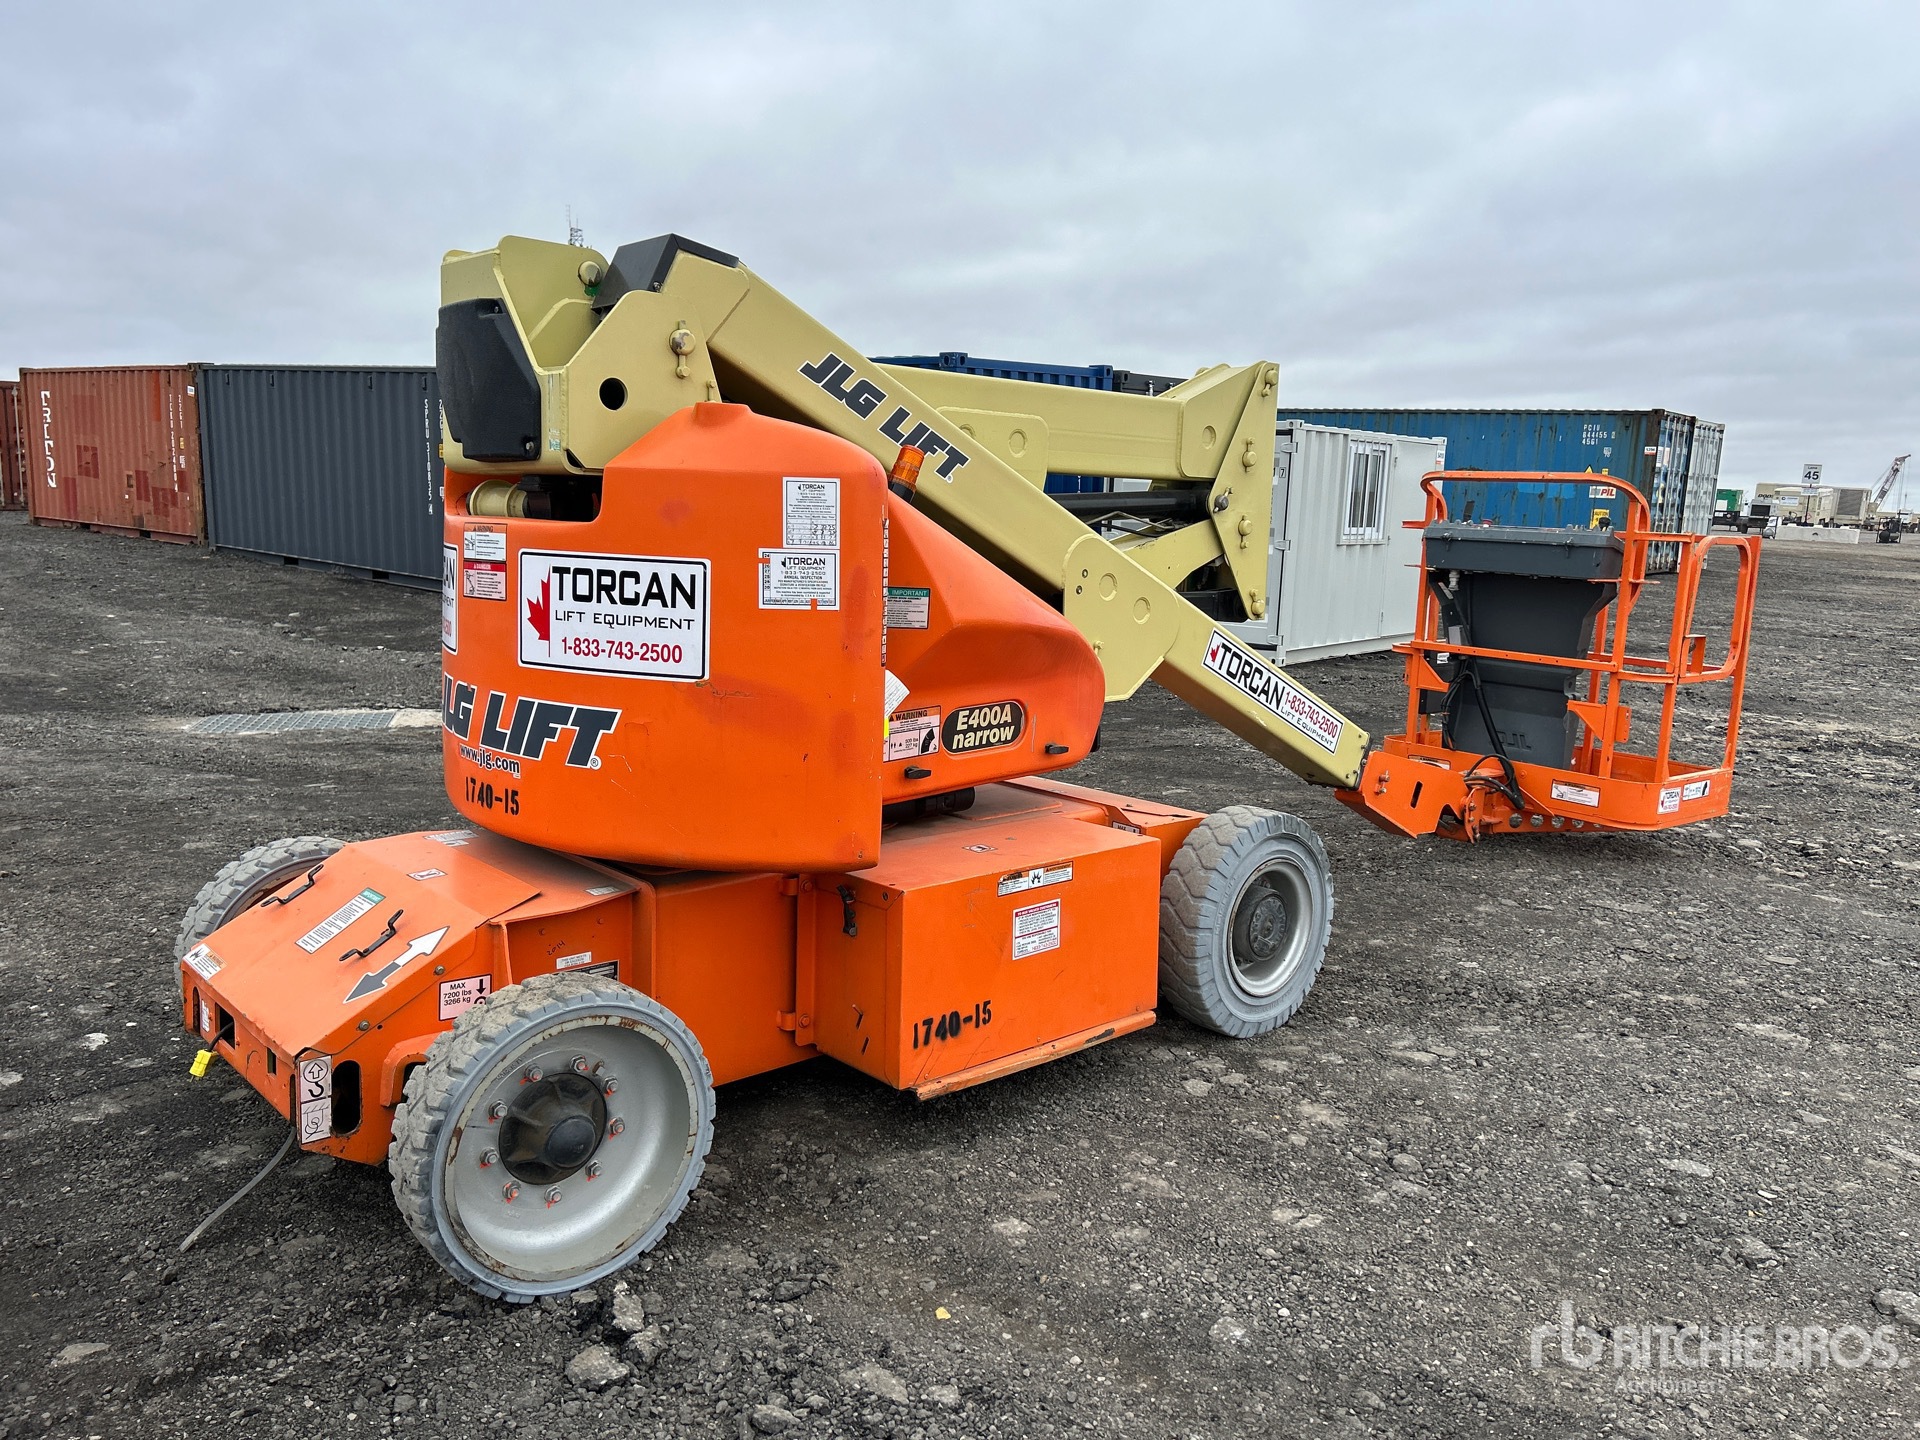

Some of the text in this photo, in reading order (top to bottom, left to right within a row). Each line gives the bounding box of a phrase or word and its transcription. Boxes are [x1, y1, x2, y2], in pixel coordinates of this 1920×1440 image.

[797, 351, 971, 479] JLG LIFT
[1611, 431, 1616, 439] 2
[1804, 471, 1819, 480] 45
[1600, 488, 1615, 497] PIL
[786, 557, 826, 566] TORCAN
[552, 565, 697, 610] TORCAN
[555, 609, 695, 630] LIFT EQUIPMENT
[561, 636, 683, 664] 1-833-743-2500
[1217, 642, 1286, 711] TORCAN
[895, 710, 928, 721] WARNING
[956, 703, 1012, 731] E400A
[1280, 706, 1334, 747] LIFT EQUIPMENT
[1284, 690, 1339, 739] 1-833-743-2500
[479, 690, 623, 769] LIFT
[951, 725, 1015, 750] narrow
[459, 743, 521, 775] www.jlg.com
[465, 776, 520, 816] 1740-15
[546, 940, 566, 956] 2014
[443, 990, 461, 999] 7200
[449, 982, 466, 990] MAX
[443, 996, 471, 1007] 3266 kg
[913, 999, 992, 1050] 1740-15
